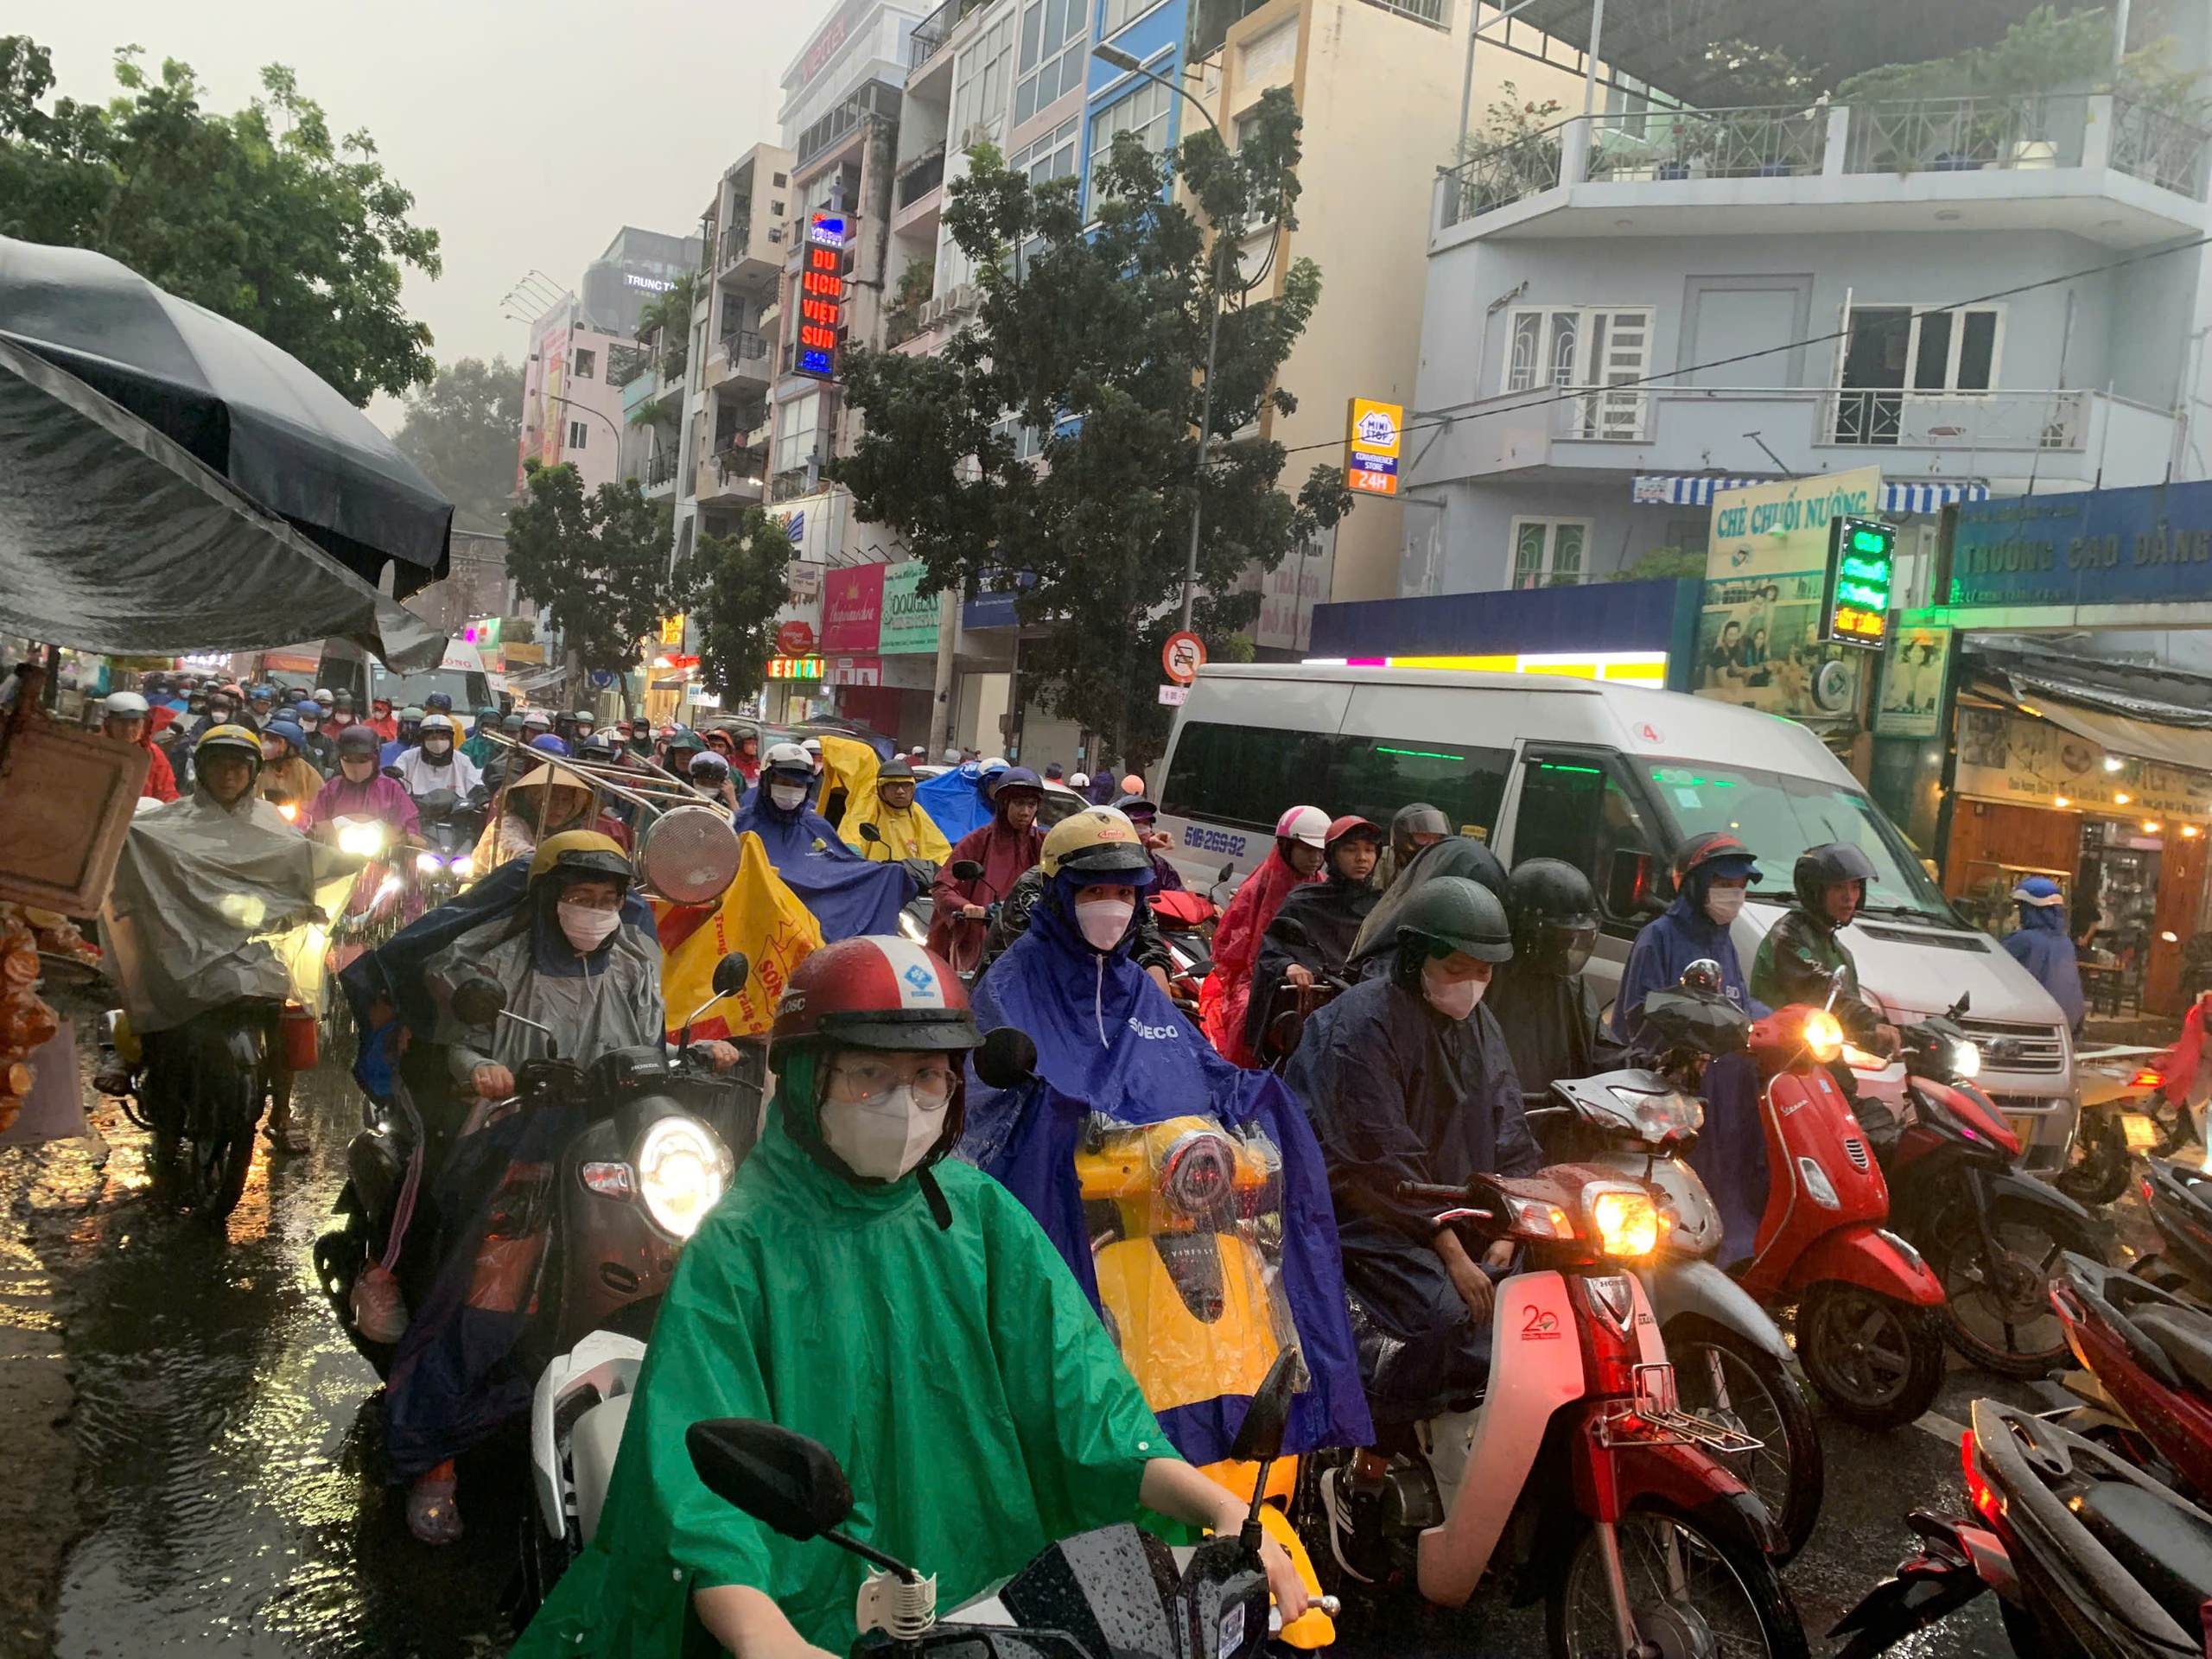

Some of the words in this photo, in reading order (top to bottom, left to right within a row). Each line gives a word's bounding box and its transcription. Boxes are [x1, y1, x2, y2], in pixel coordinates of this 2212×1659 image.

[812, 249, 836, 270] DU
[627, 274, 663, 291] TRUNG
[804, 271, 841, 296] LỊCH
[803, 298, 837, 325] VIỆT
[802, 325, 834, 348] SUN
[1366, 429, 1389, 442] STOP
[1368, 420, 1389, 431] MINI
[1364, 461, 1384, 472] STORE
[1358, 472, 1388, 490] 24H
[1717, 499, 1748, 538] CHÈ
[1751, 486, 1802, 536] CHUỐI
[1804, 486, 1867, 529] NƯỚNG
[1963, 536, 2055, 575] TRƯỜNG
[2068, 535, 2122, 569] CAO
[1643, 725, 1658, 741] 4
[715, 912, 728, 956] Trung
[760, 960, 784, 998] SƠN
[1599, 1279, 1630, 1287] HOND
